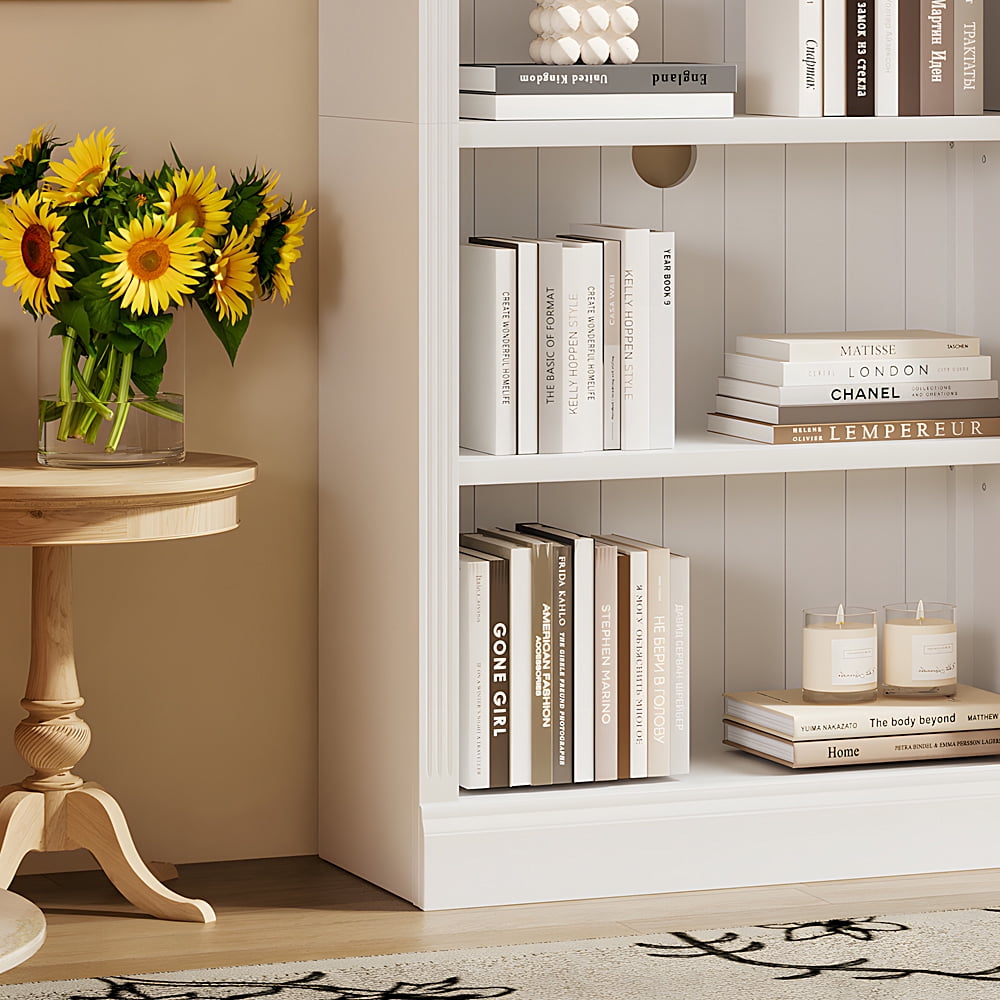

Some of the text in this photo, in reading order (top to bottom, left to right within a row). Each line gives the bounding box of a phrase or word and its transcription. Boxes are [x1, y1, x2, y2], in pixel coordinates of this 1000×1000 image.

[928, 50, 946, 82] Иден
[963, 22, 976, 90] ТРАКТАТЫ
[520, 74, 607, 85] United Kingdom
[653, 70, 707, 85] England
[502, 291, 510, 405] CREATE WONDERFUL HOMELIFE
[546, 288, 555, 404] THE BASIC OF FORMAT
[624, 270, 633, 400] KELLY HOPPEN STYLE
[840, 345, 896, 356] MATISSE
[569, 294, 578, 415] KELLY HOPPEN STYLE
[849, 365, 929, 378] LONDON
[831, 387, 900, 400] CHANEL
[830, 421, 983, 441] LEMPEREUR
[653, 616, 665, 633] НЕ
[542, 603, 551, 728] AMERICAN FASHION
[602, 605, 611, 725] STEPHEN MARINO
[653, 637, 665, 672] БЕРИ
[493, 623, 506, 737] GONE GIRL
[653, 689, 665, 744] ГОЛОВУ
[870, 713, 956, 730] The body beyond
[968, 713, 998, 721] MATTHEW
[828, 746, 860, 759] Home
